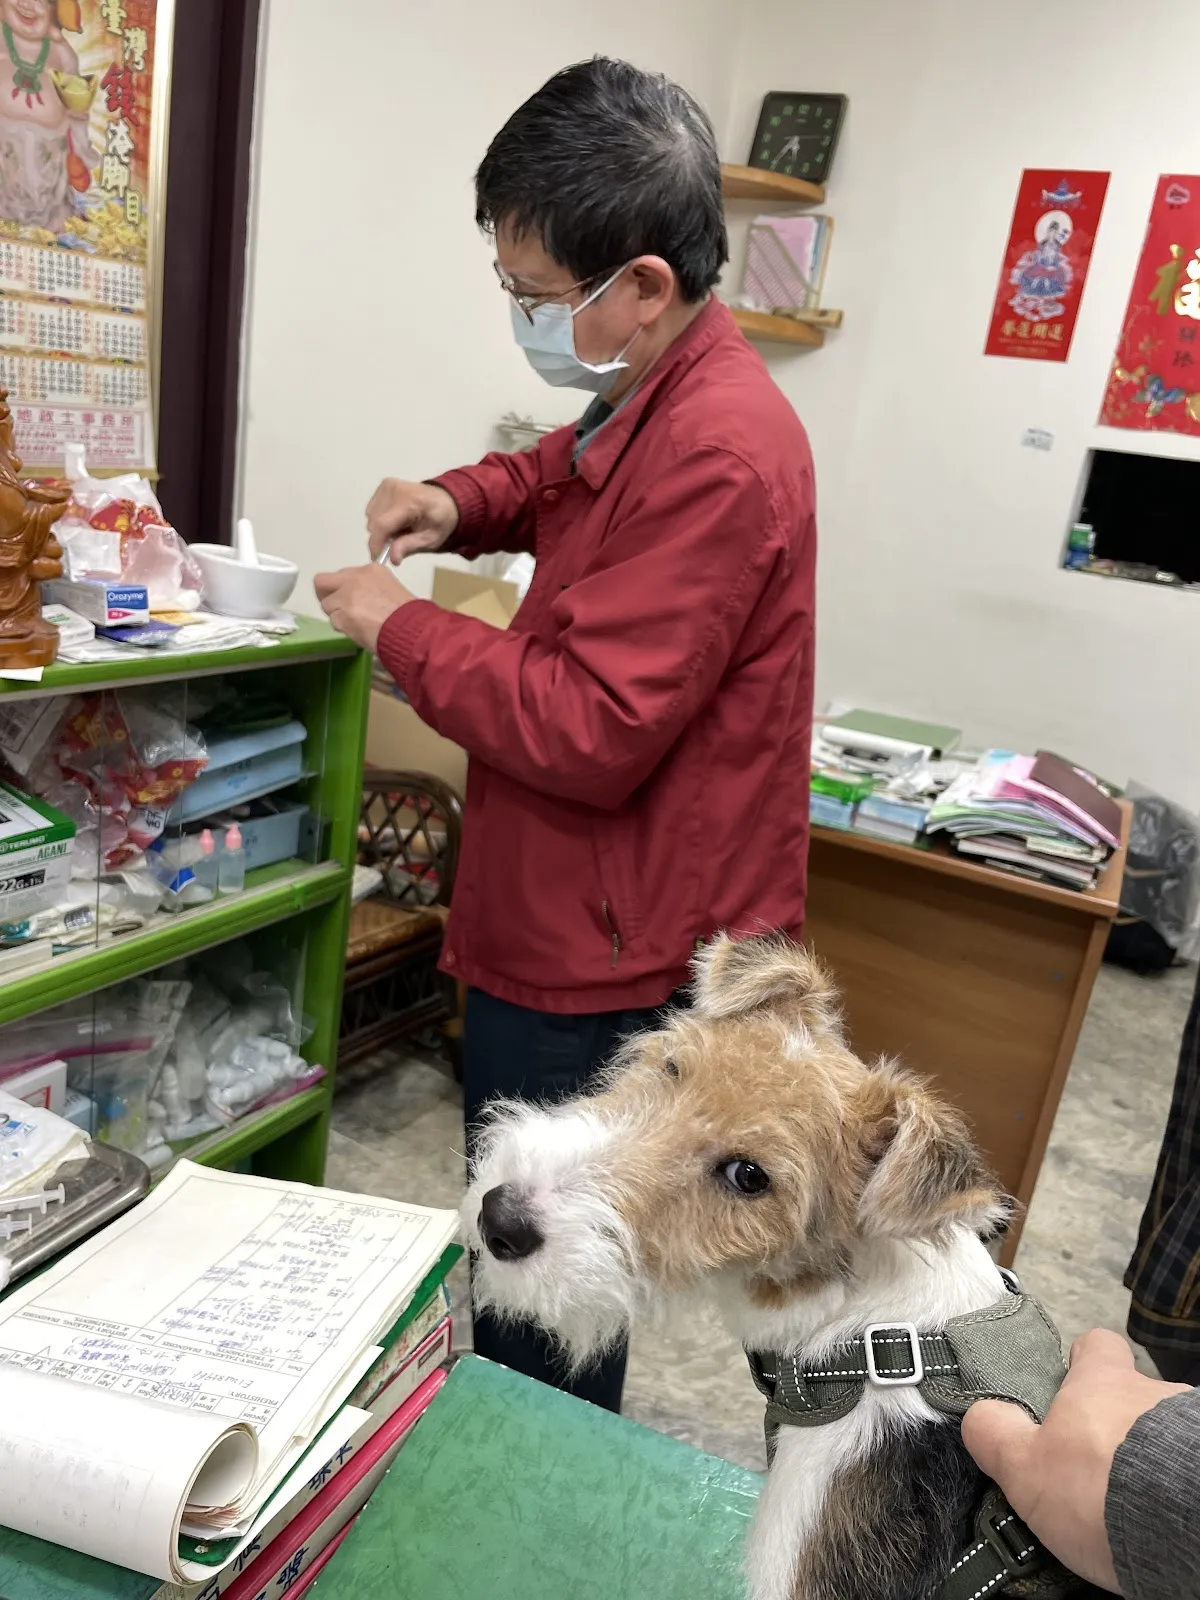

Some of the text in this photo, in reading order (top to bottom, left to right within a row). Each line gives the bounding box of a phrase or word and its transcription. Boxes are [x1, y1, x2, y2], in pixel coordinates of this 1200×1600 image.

[37, 841, 67, 860] AGANI
[193, 1402, 213, 1412] Breed
[243, 1412, 268, 1422] Species
